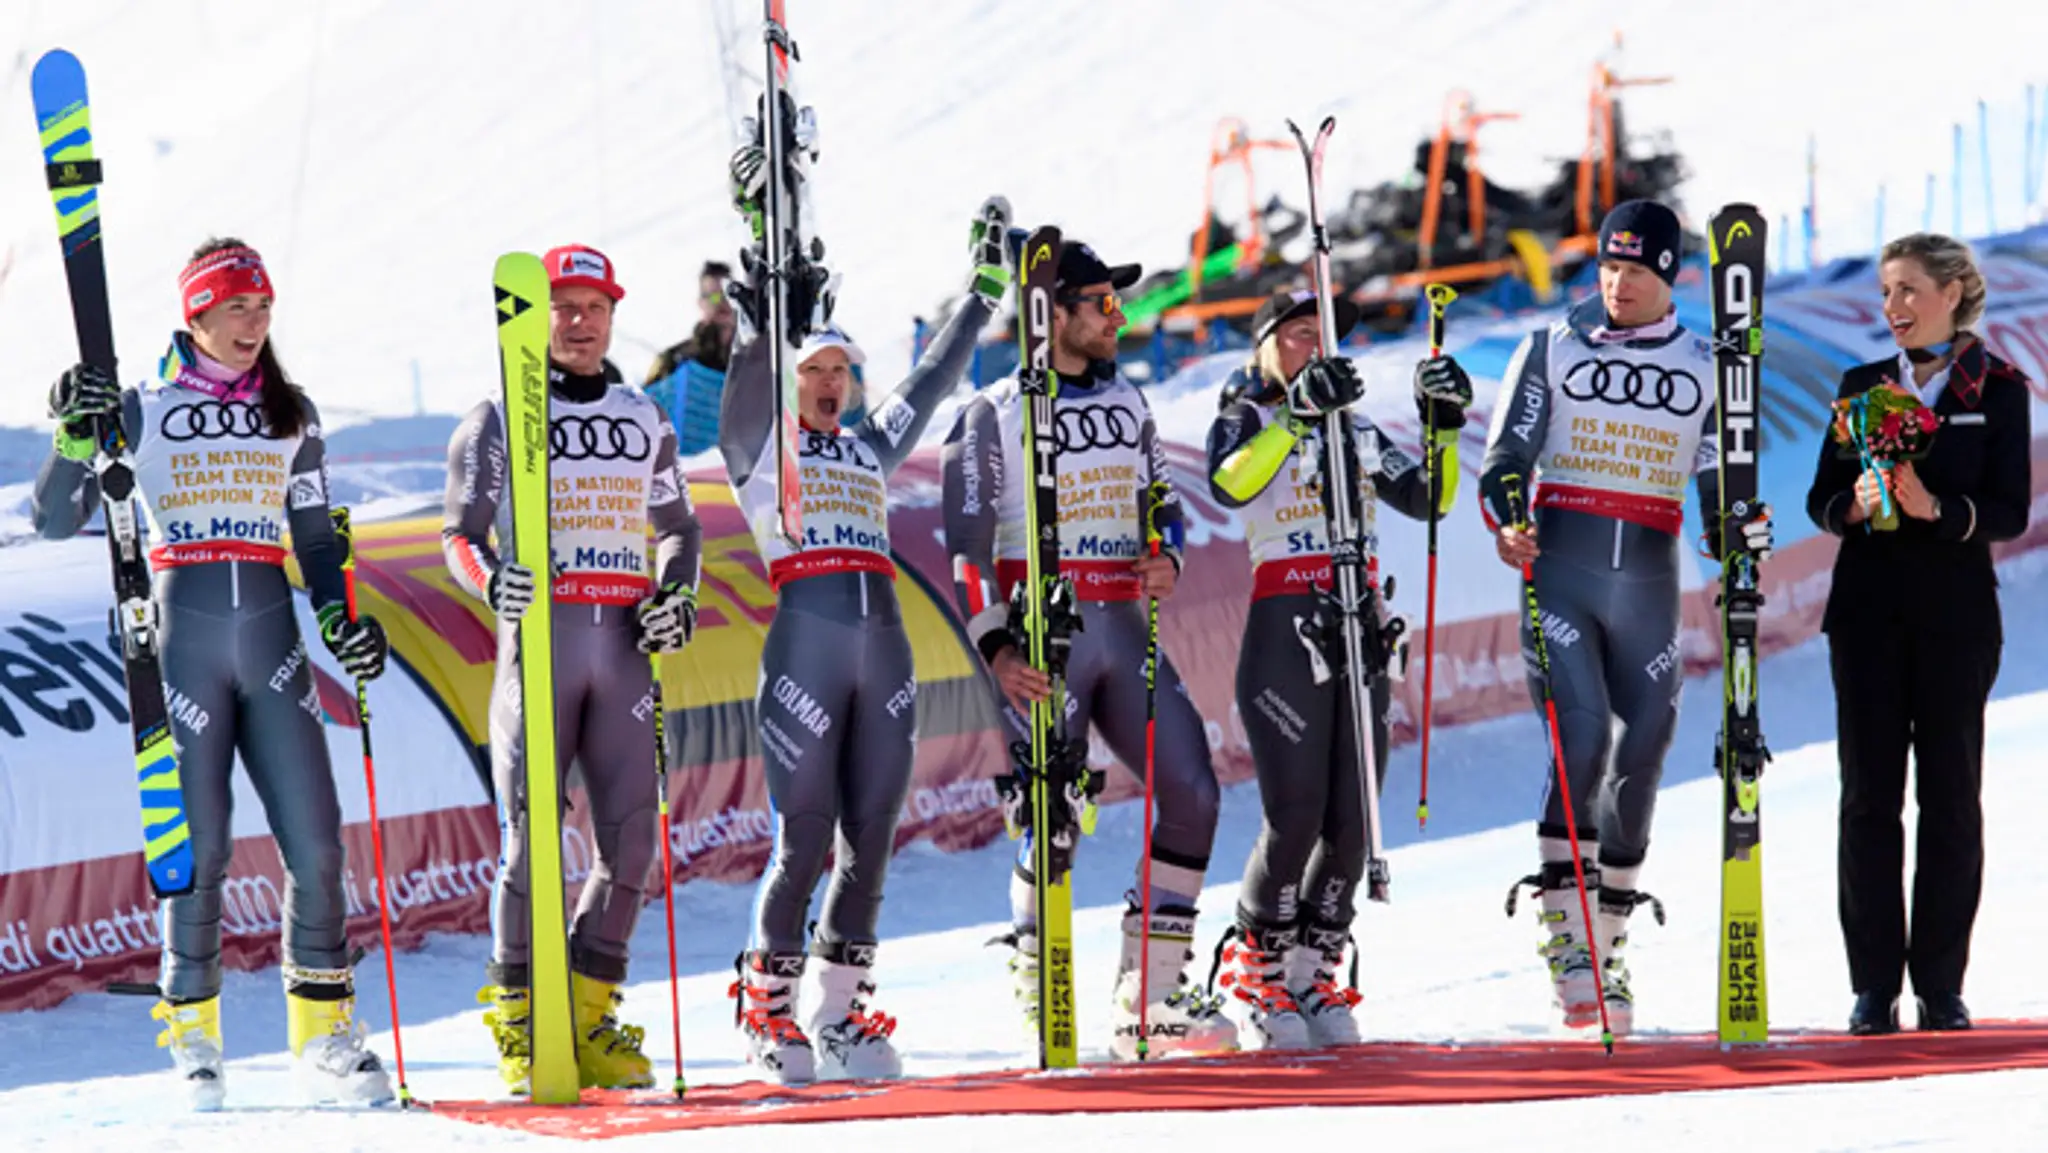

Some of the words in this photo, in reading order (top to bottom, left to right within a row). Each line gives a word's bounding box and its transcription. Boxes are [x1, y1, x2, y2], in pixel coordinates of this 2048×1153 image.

[1512, 382, 1544, 443] Audi
[1572, 416, 1598, 434] FIS
[1604, 420, 1680, 448] NATIONS
[171, 451, 201, 469] FIS
[207, 450, 285, 468] NATIONS
[1571, 436, 1617, 456] TEAM
[1623, 444, 1675, 465] EVENT
[171, 470, 225, 488] TEAM
[1553, 454, 1641, 480] CHAMPION
[553, 477, 570, 493] IS
[158, 488, 254, 512] CHAMPION
[167, 520, 205, 544] St.
[802, 527, 829, 546] t.
[1287, 530, 1326, 554] St.
[575, 545, 642, 572] Moritz
[1284, 565, 1331, 584] Aud
[554, 581, 578, 596] di
[772, 675, 832, 739] COLMAR
[369, 857, 498, 923] quattro
[1729, 921, 1744, 1022] SUPER
[1744, 921, 1760, 1022] SHAPE
